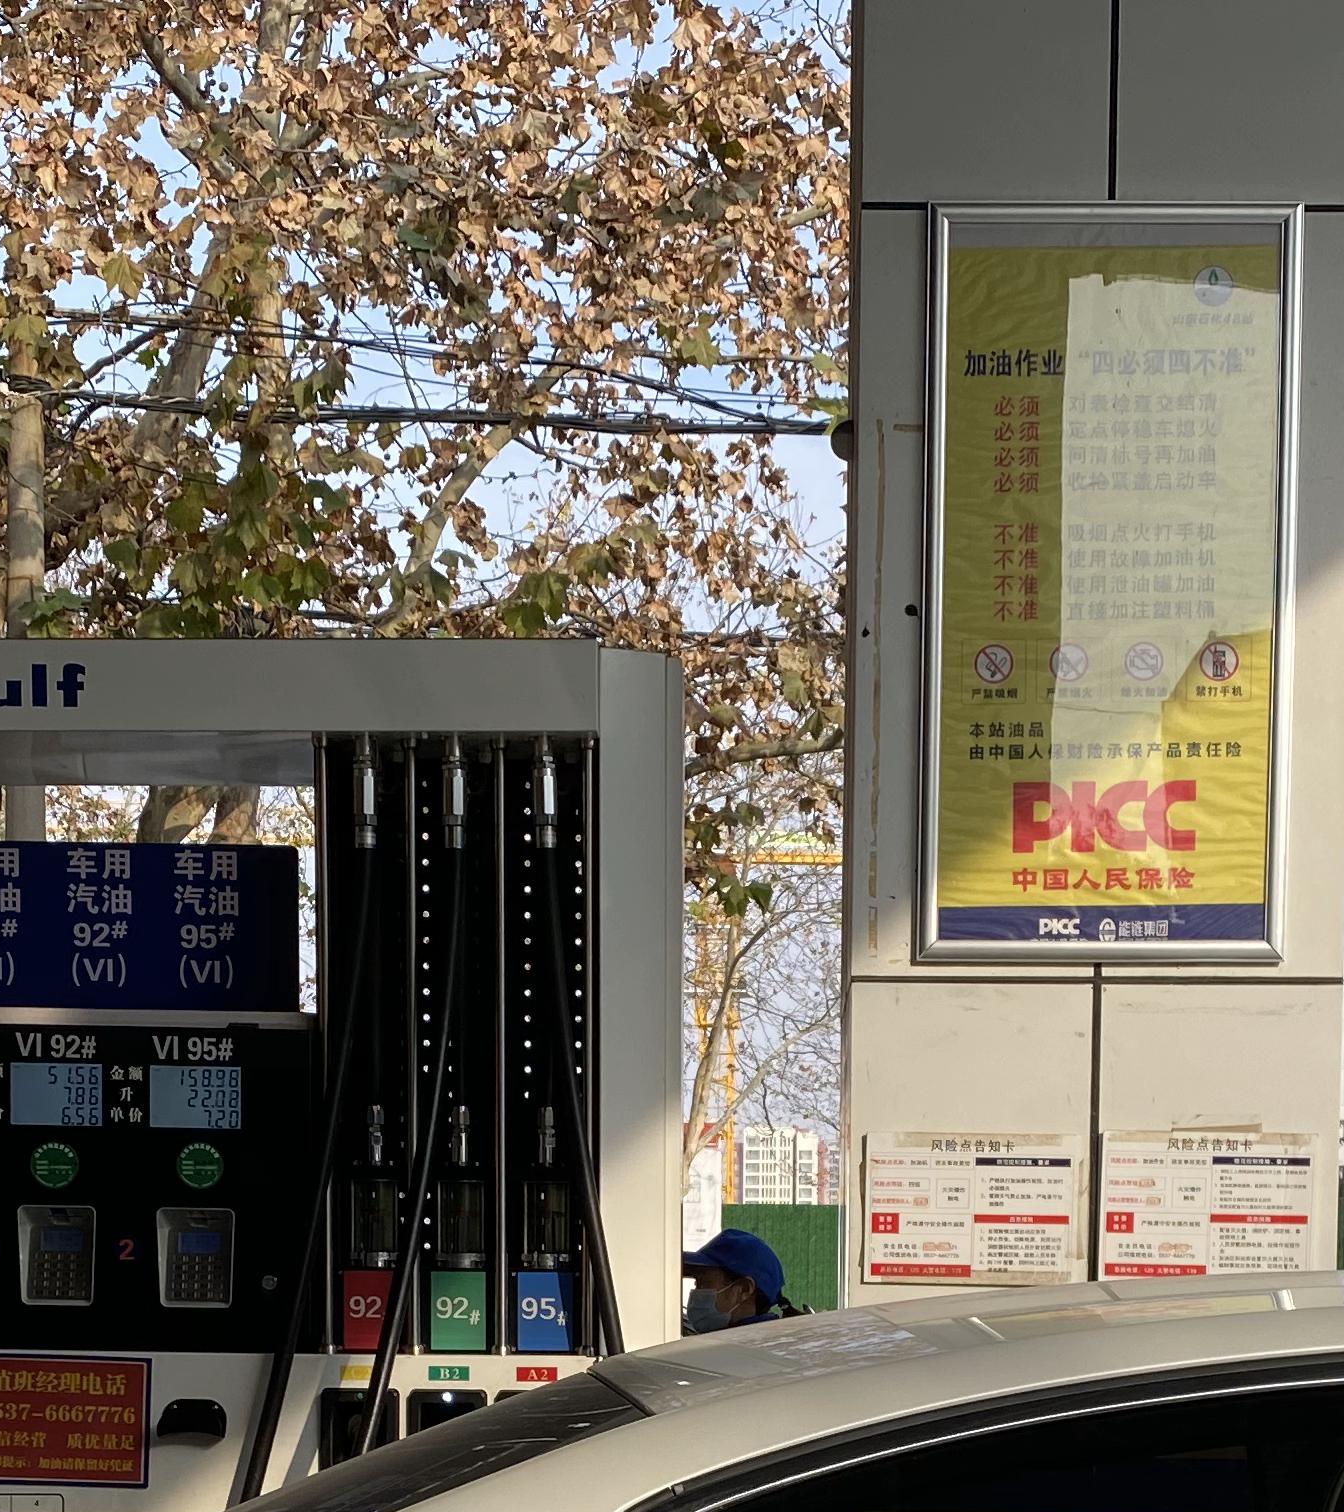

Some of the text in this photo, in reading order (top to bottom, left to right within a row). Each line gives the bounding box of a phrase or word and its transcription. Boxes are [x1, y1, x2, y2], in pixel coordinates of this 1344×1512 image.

[994, 396, 1040, 417] 必须
[994, 422, 1040, 442] 必须
[994, 447, 1040, 468] 必须
[994, 472, 1040, 493] 必须
[994, 524, 1040, 545] 不准
[994, 549, 1040, 570] 不准
[994, 575, 1040, 596] 不准
[994, 601, 1040, 622] 不准
[969, 721, 1044, 739] 本站油品
[969, 741, 1243, 761] 由中国人保财险承保产品责任险
[1011, 779, 1198, 854] PICC
[66, 847, 132, 881] 车用
[174, 849, 239, 881] 车用
[1011, 867, 1197, 893] 中国人民保险
[66, 883, 133, 915] 汽油
[174, 885, 240, 917] 汽油
[72, 919, 128, 948] 92#
[180, 920, 235, 949] 95#
[1038, 918, 1081, 935] PICC
[15, 1032, 97, 1059] VI 92#
[152, 1035, 234, 1061] VI 95#
[47, 1066, 99, 1085] 51.56
[109, 1065, 143, 1081] 金额
[180, 1069, 240, 1088] 158.98
[119, 1086, 133, 1102] 升
[187, 1089, 240, 1108] 22.08
[61, 1106, 99, 1126] 6.56
[110, 1106, 143, 1123] 单价
[931, 1137, 1016, 1153] 风险点告知卡
[1167, 1136, 1254, 1152] 风险点告知卡
[119, 1239, 136, 1261] 2
[349, 1295, 385, 1320] 92
[435, 1296, 481, 1326] 92#
[521, 1296, 569, 1327] 95#
[67, 1432, 136, 1451] 质优量足
